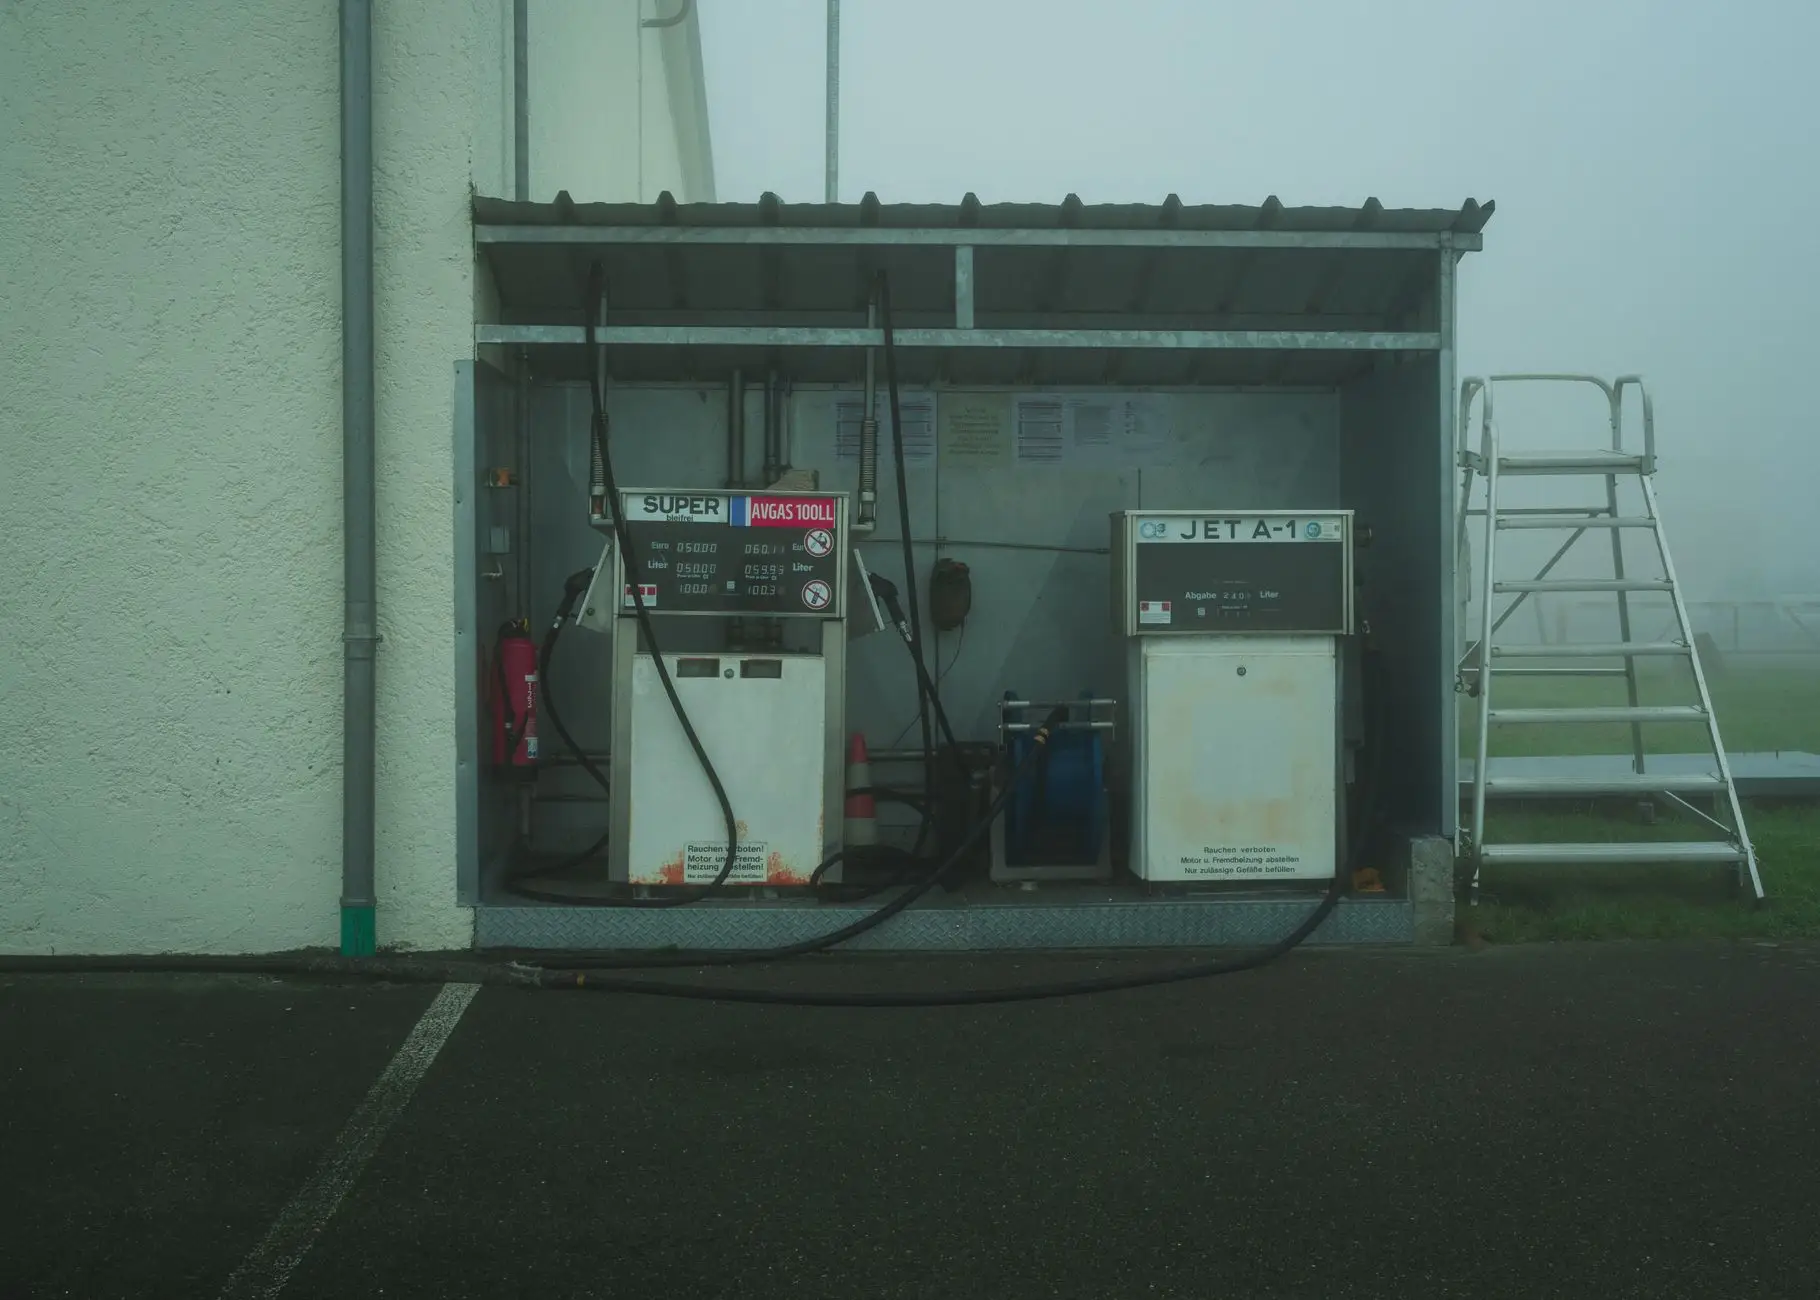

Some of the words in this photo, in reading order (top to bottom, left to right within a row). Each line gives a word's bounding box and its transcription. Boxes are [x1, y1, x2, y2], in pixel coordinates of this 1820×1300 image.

[643, 495, 720, 515] SUPER
[752, 503, 793, 520] AVGAS
[796, 504, 834, 521] 100LL
[666, 514, 694, 522] bleifrei
[1180, 520, 1241, 539] JET
[1252, 520, 1296, 539] A-1
[651, 542, 670, 550] Euro
[792, 543, 804, 552] Eur
[647, 560, 669, 569] Liter
[792, 562, 814, 573] Liter
[1185, 591, 1217, 601] Abgabe
[1260, 590, 1280, 599] Liter
[687, 845, 723, 853] Rauchen
[726, 845, 764, 853] vboten!
[1203, 846, 1237, 854] Rauchen
[687, 855, 712, 863] Motor
[715, 855, 729, 863] un
[735, 855, 764, 863] Fremd-
[1212, 856, 1263, 865] Fremdheizung
[1265, 855, 1300, 863] abstellen
[687, 863, 719, 872] heizung
[730, 863, 764, 871] stellen!
[1200, 866, 1234, 875] zulässige
[1265, 865, 1296, 873] befüllen
